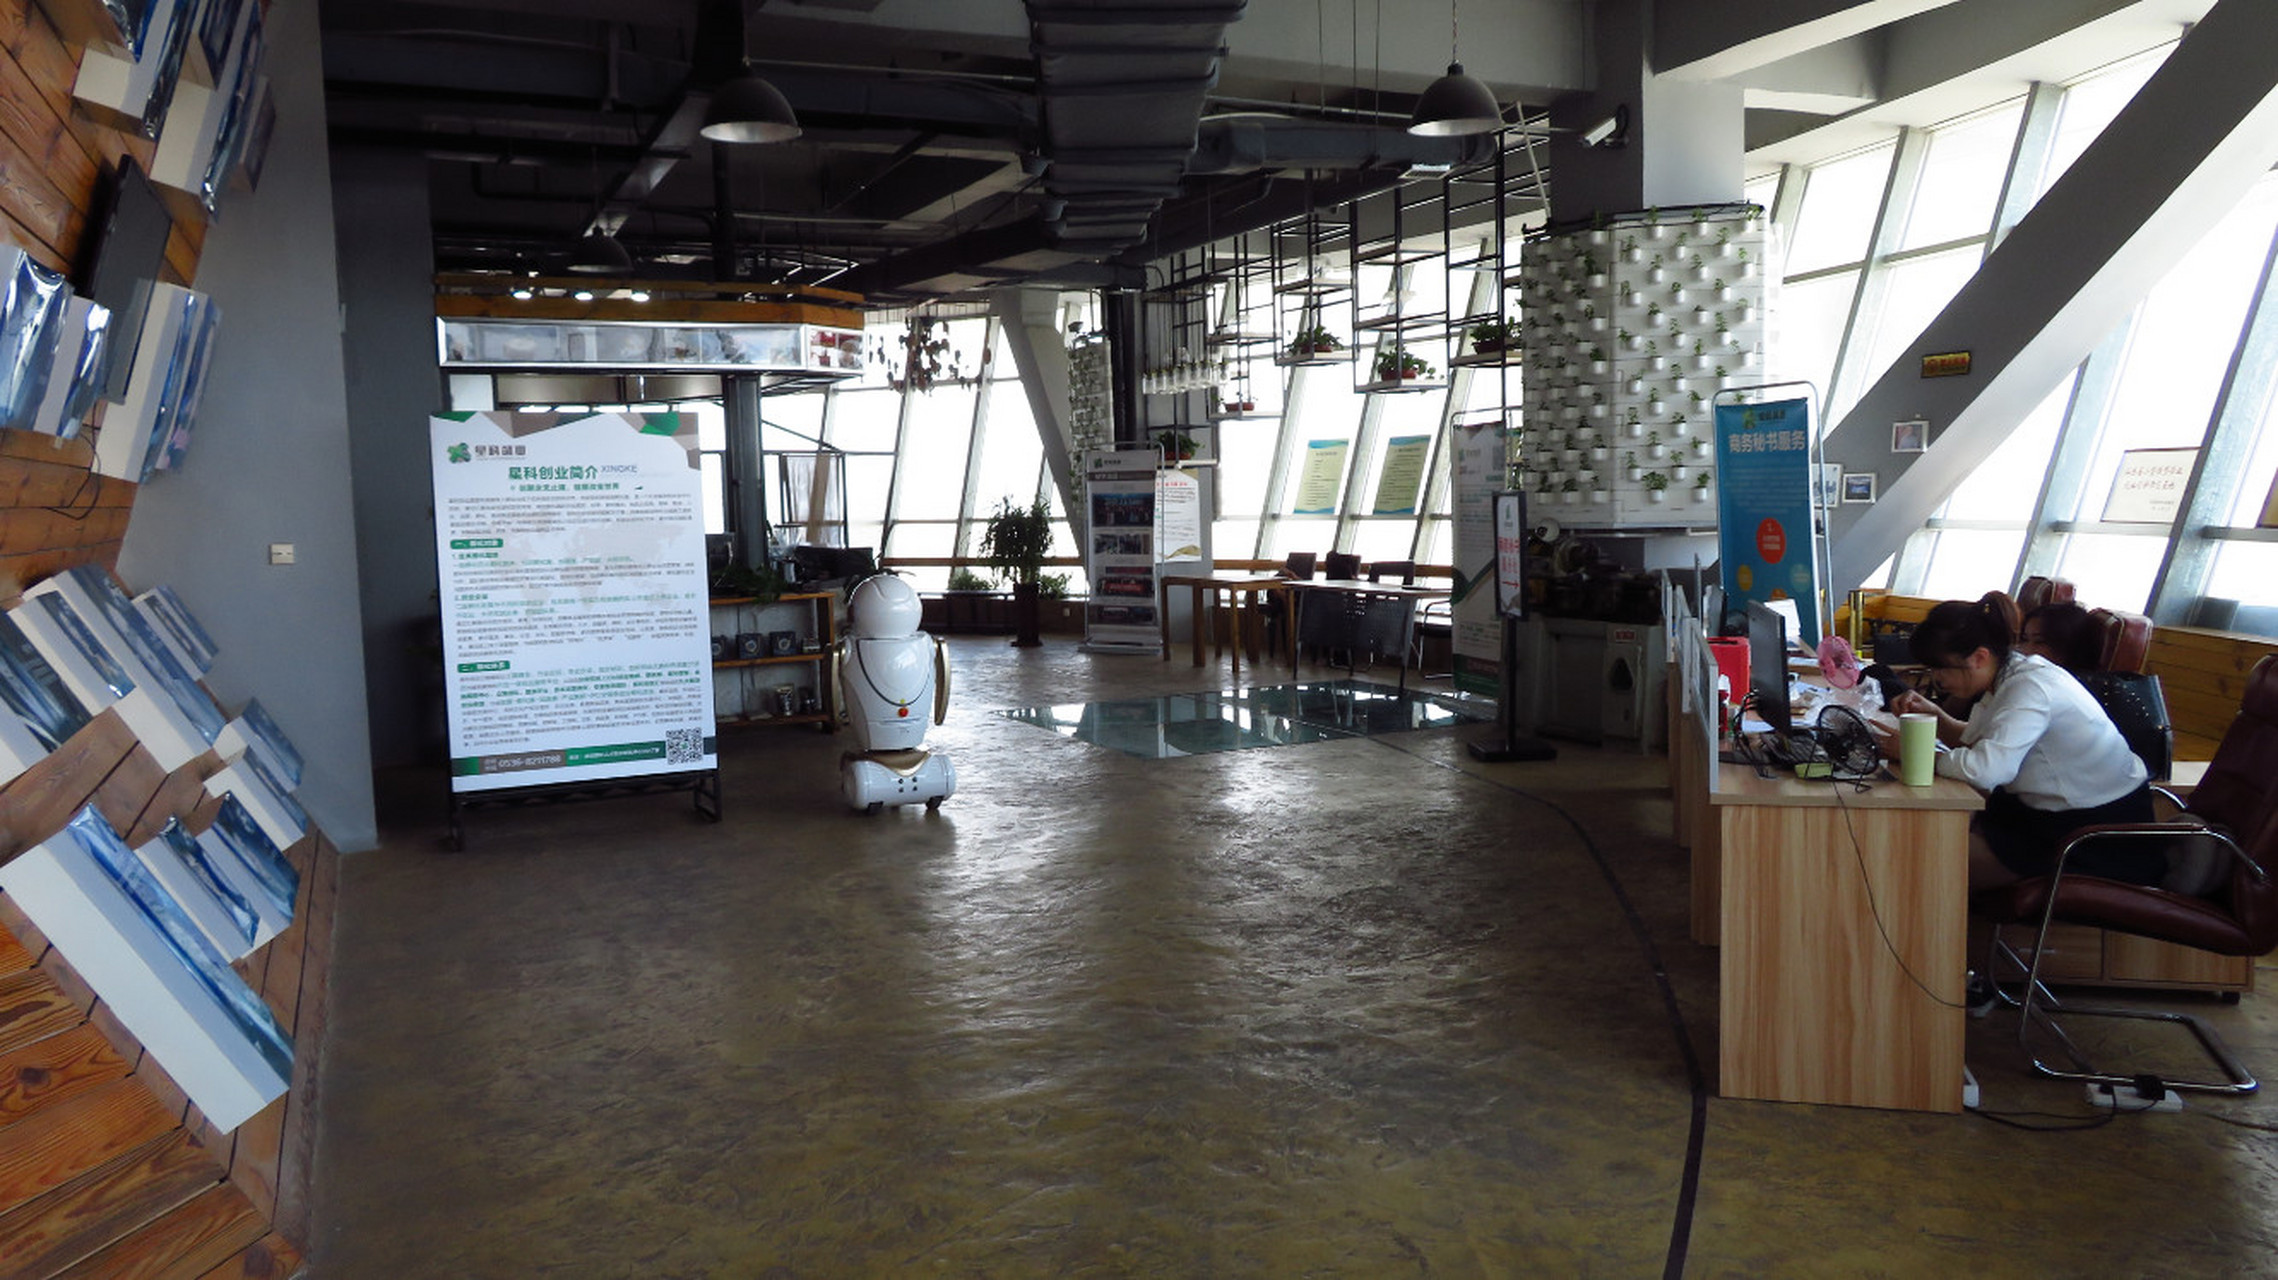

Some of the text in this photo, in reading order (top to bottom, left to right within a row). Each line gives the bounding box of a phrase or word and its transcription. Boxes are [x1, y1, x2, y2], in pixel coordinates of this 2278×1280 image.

[1728, 430, 1806, 453] 商务秘书服务
[508, 465, 598, 480] 星科创业简介
